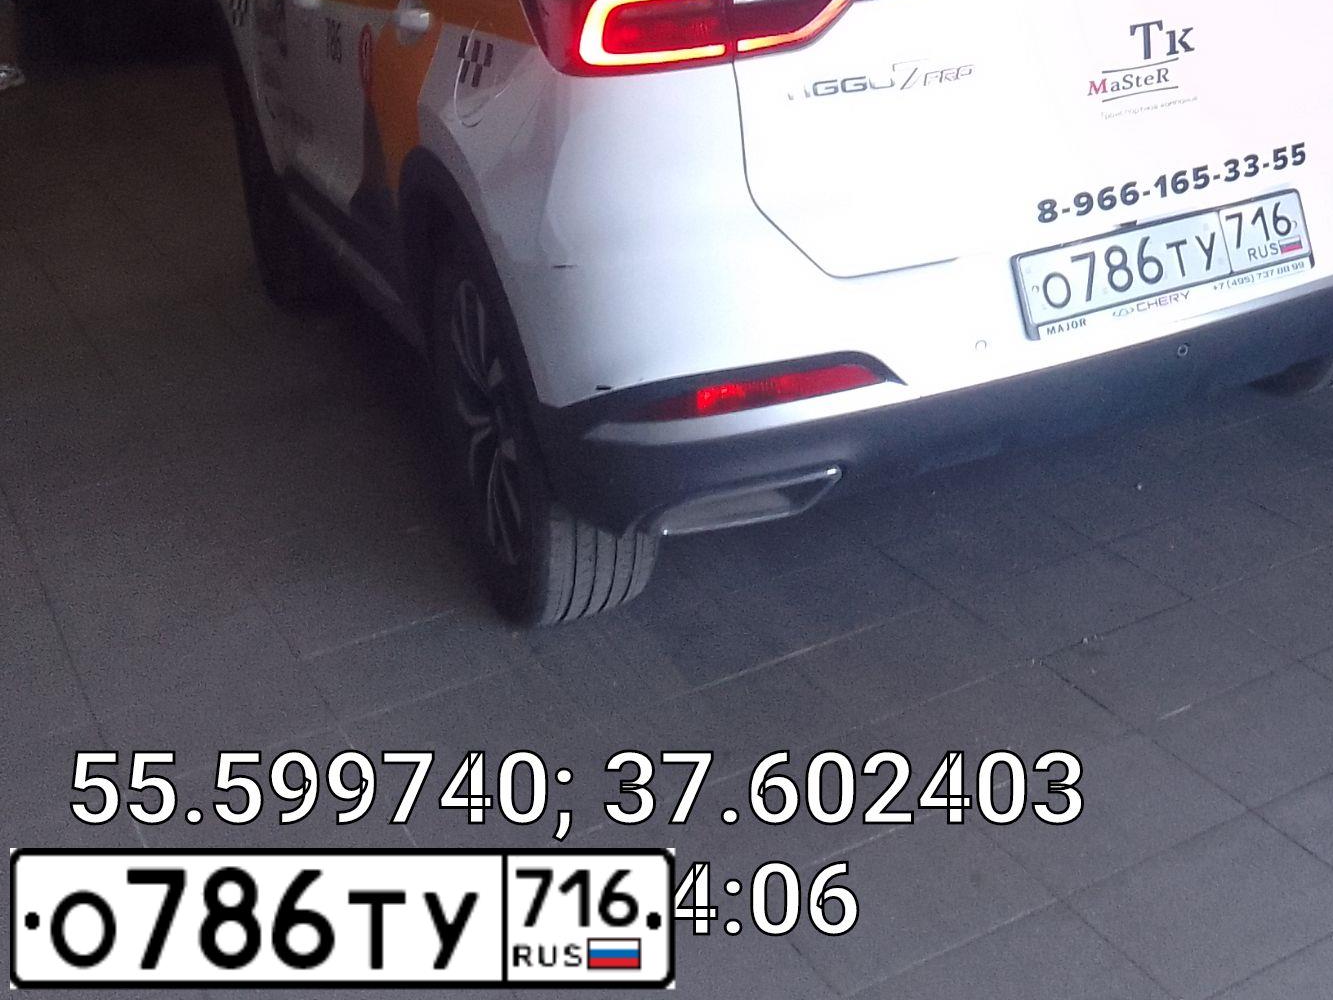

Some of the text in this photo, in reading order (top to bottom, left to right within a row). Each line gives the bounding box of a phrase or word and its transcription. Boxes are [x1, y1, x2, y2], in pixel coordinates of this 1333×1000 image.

[1037, 141, 1307, 224] 8-966-165-33-55
[1224, 201, 1293, 250] 716
[1247, 242, 1279, 261] RUS
[1136, 289, 1191, 313] CHERY
[1046, 317, 1087, 336] MAJOR
